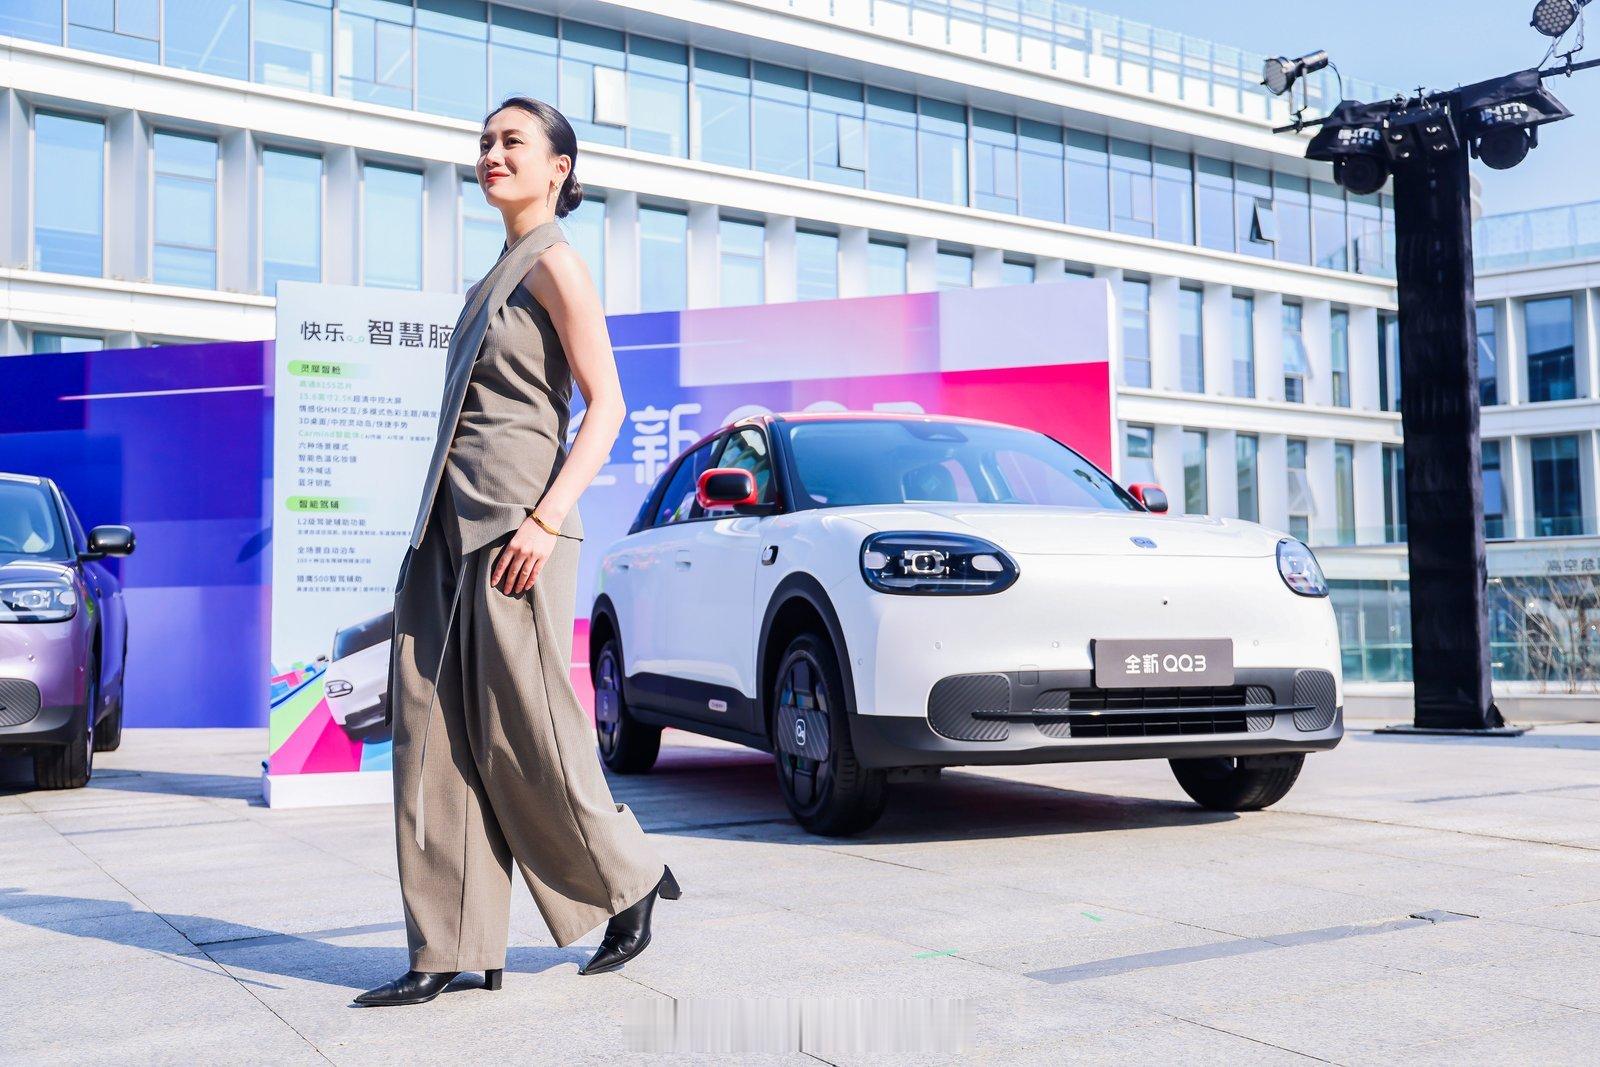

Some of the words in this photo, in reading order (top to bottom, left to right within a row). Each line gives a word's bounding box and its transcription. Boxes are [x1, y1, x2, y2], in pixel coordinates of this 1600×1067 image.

[300, 320, 345, 342] 快乐
[368, 318, 453, 349] 智慧脑
[1547, 557, 1600, 572] 高空危
[1163, 653, 1207, 672] QQ3
